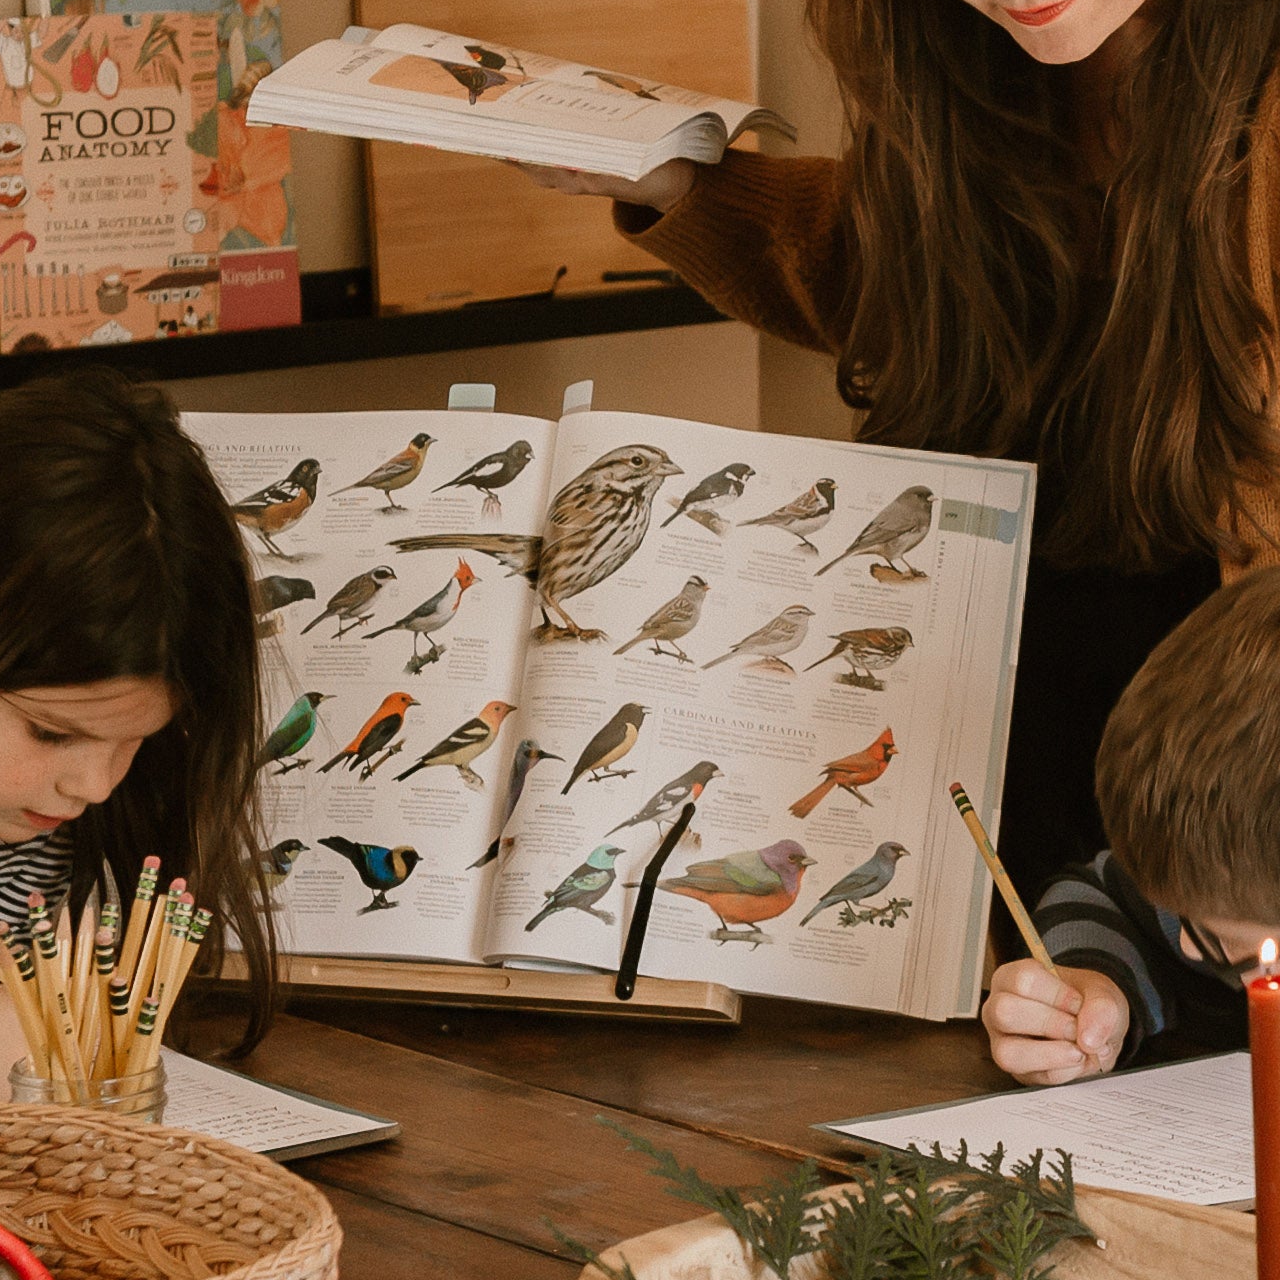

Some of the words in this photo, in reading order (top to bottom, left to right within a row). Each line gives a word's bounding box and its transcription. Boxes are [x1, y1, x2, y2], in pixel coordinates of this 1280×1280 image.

[40, 106, 176, 141] FOOD
[37, 138, 174, 164] ANATOMY
[220, 265, 286, 287] Kingdom
